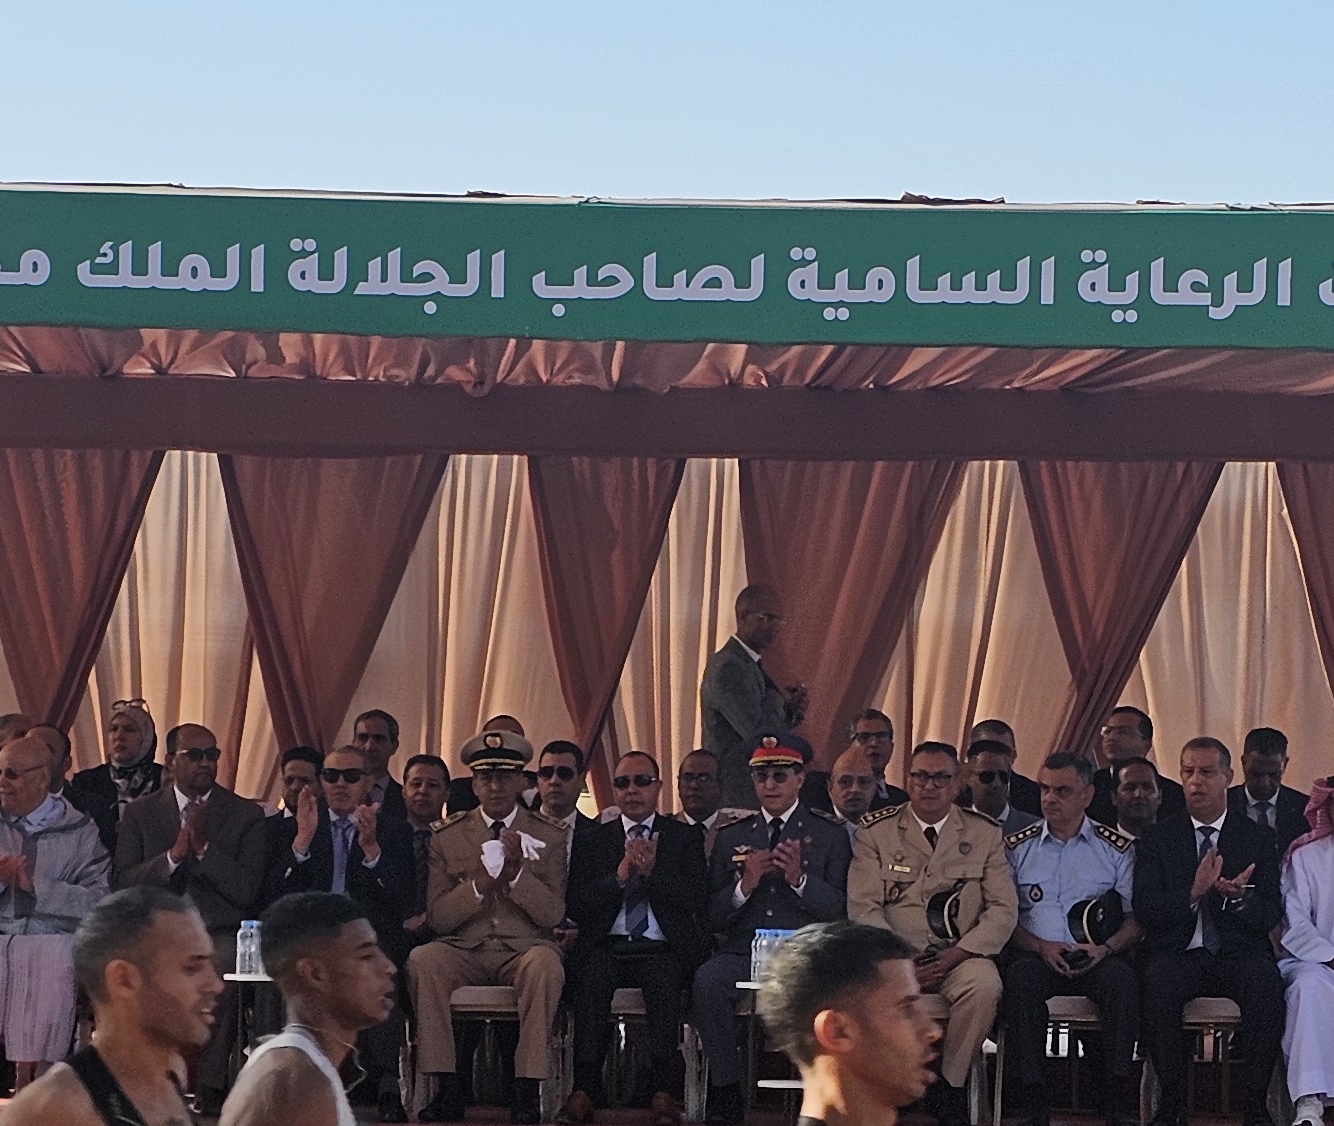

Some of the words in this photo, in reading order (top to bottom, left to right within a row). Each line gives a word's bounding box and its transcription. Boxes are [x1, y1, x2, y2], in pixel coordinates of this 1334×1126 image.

[77, 241, 265, 292] الملك
[288, 239, 505, 315] الجلالة
[533, 252, 765, 316] لصاحب
[788, 247, 1055, 318] السامية
[1078, 250, 1292, 322] الرعاية
